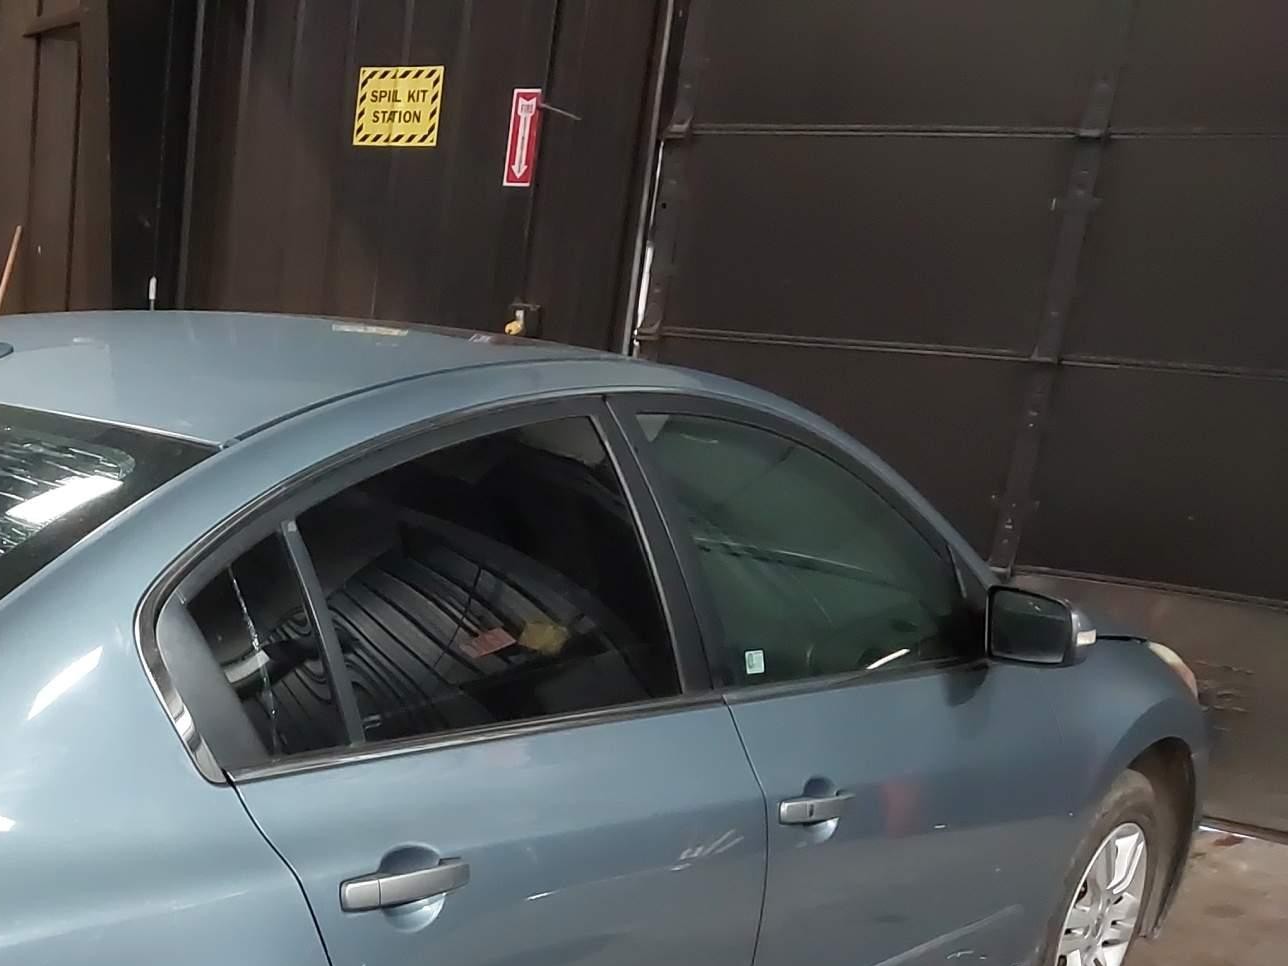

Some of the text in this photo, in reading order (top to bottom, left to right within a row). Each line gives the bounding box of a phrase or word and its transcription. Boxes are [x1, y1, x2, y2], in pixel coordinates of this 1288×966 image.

[370, 89, 429, 104] SPILL KIT
[372, 110, 423, 124] STATION
